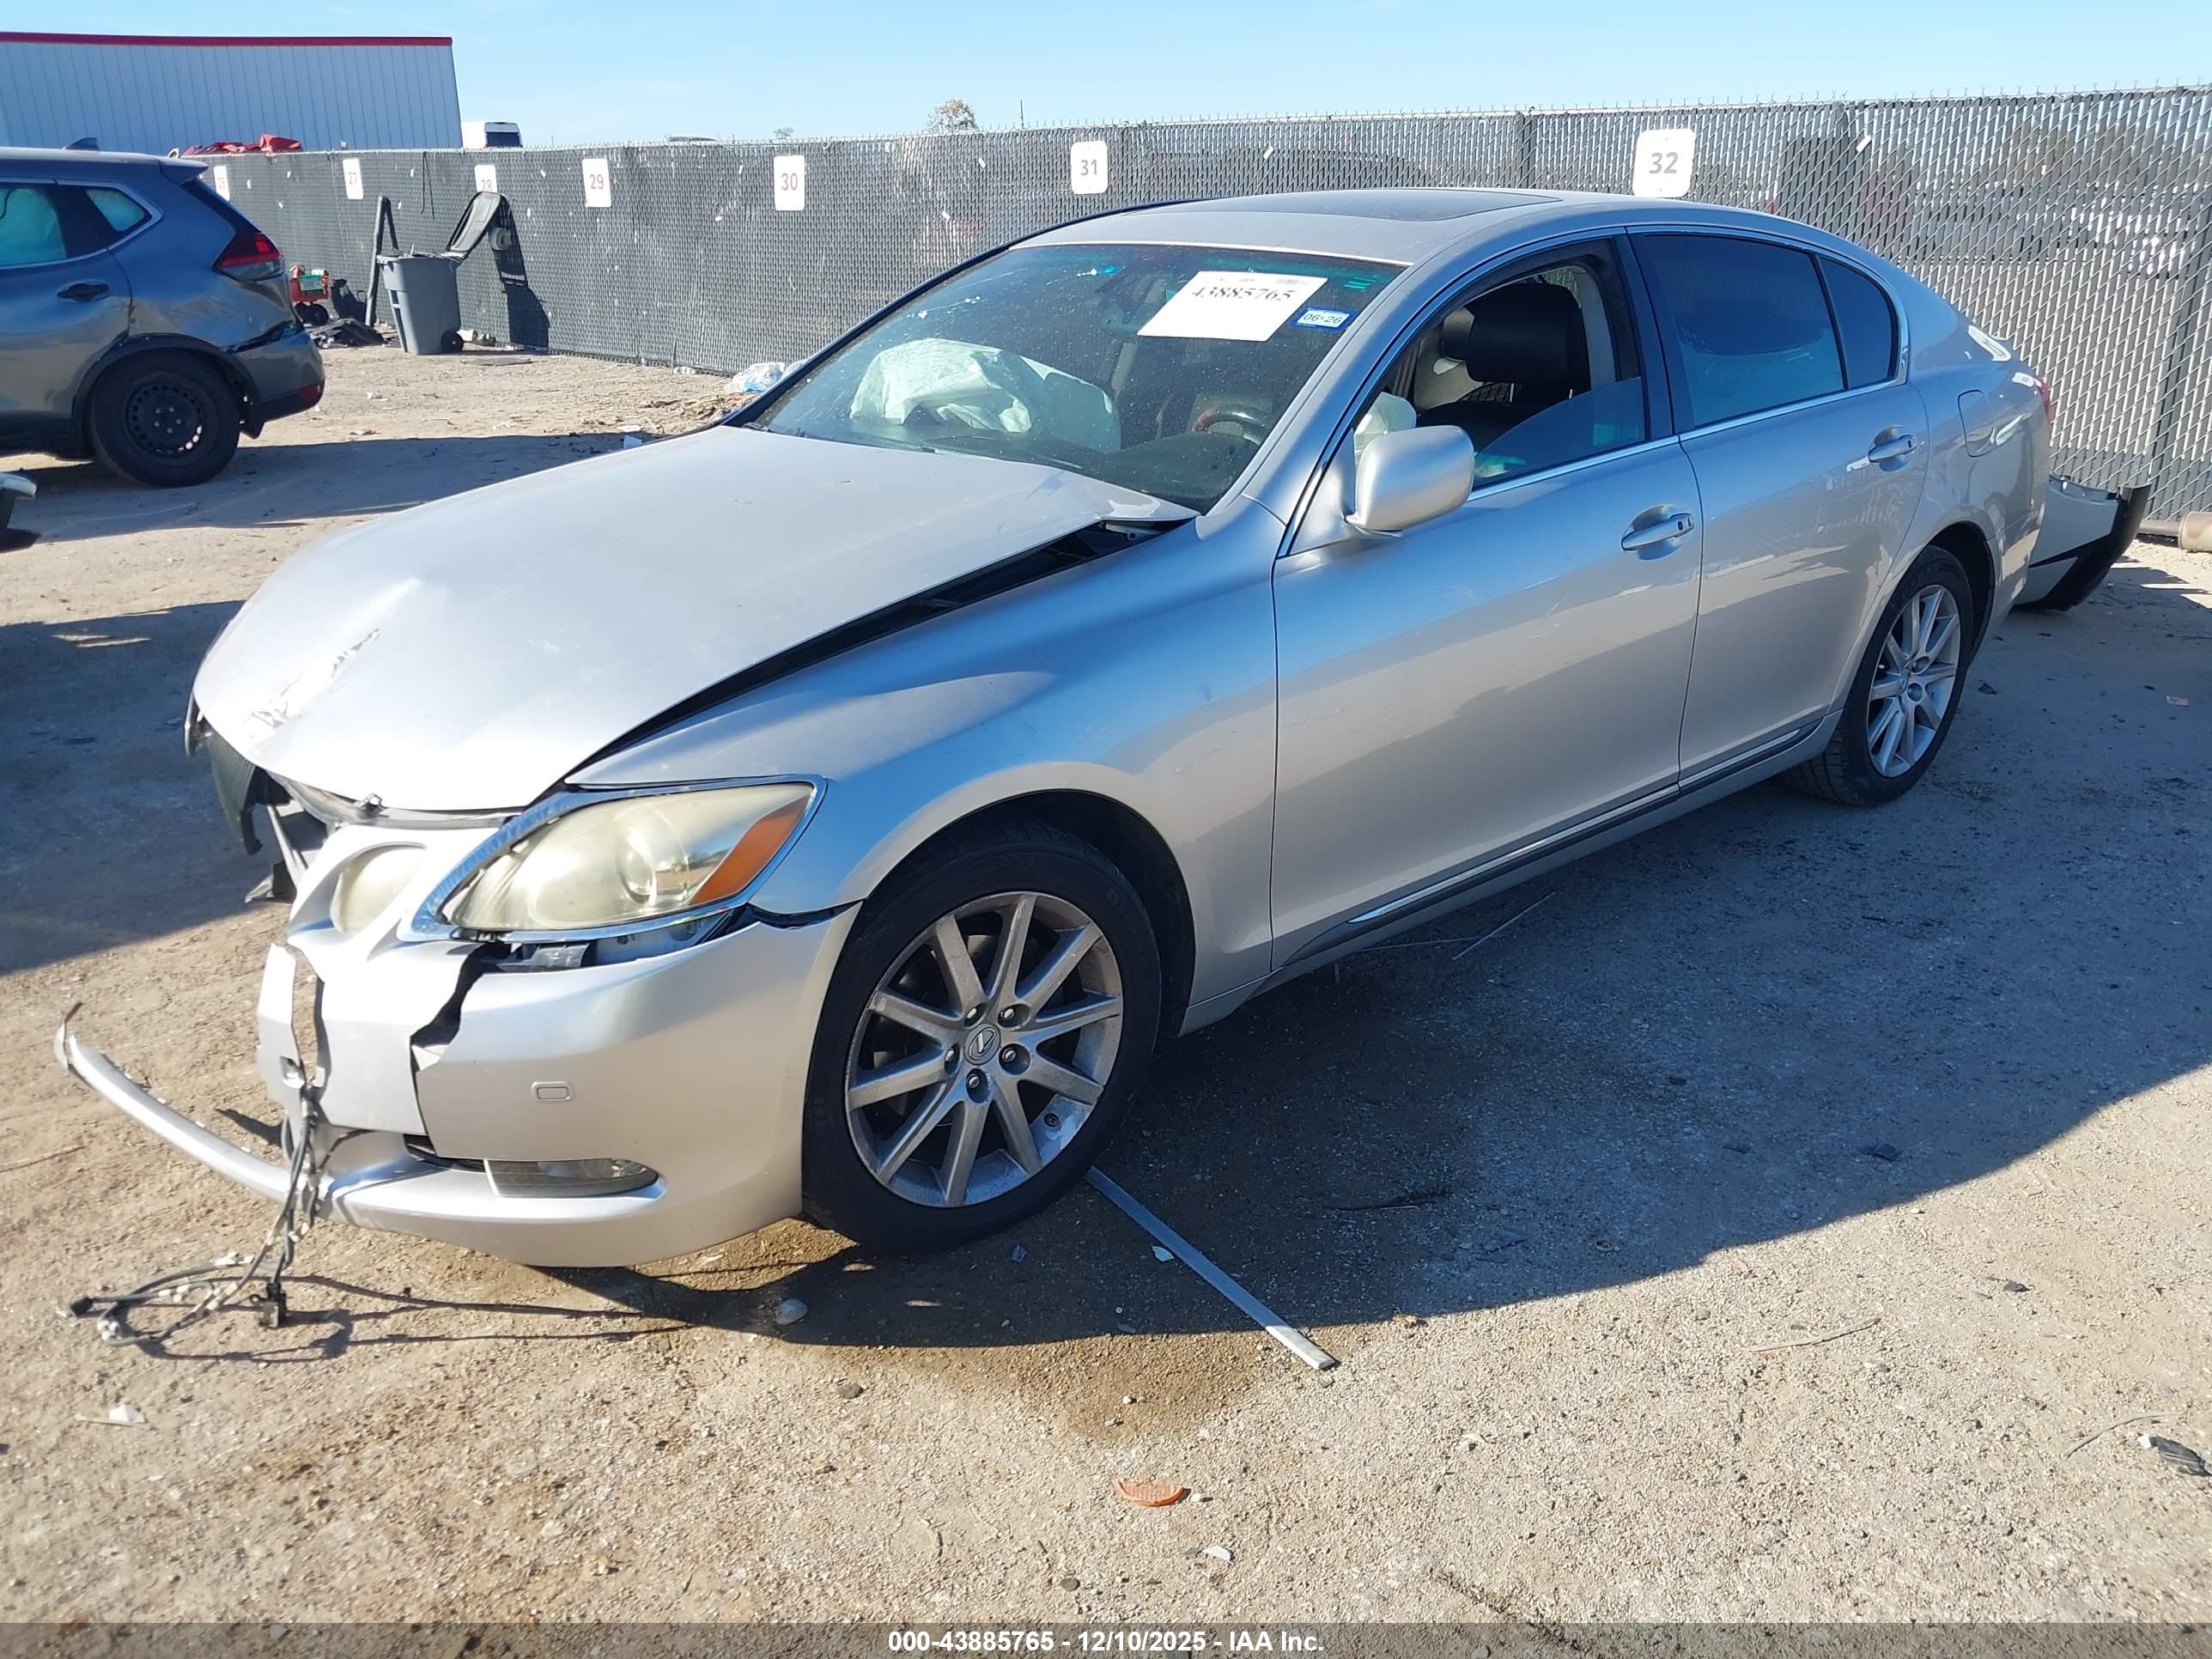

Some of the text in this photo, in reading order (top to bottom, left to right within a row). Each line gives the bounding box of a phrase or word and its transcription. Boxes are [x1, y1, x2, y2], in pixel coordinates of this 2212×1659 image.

[1080, 159, 1097, 176] 31
[1649, 152, 1679, 174] 32
[348, 172, 357, 185] 27
[481, 179, 493, 192] 28
[589, 173, 605, 190] 29
[781, 173, 798, 191] 30
[1191, 286, 1297, 301] 43885765
